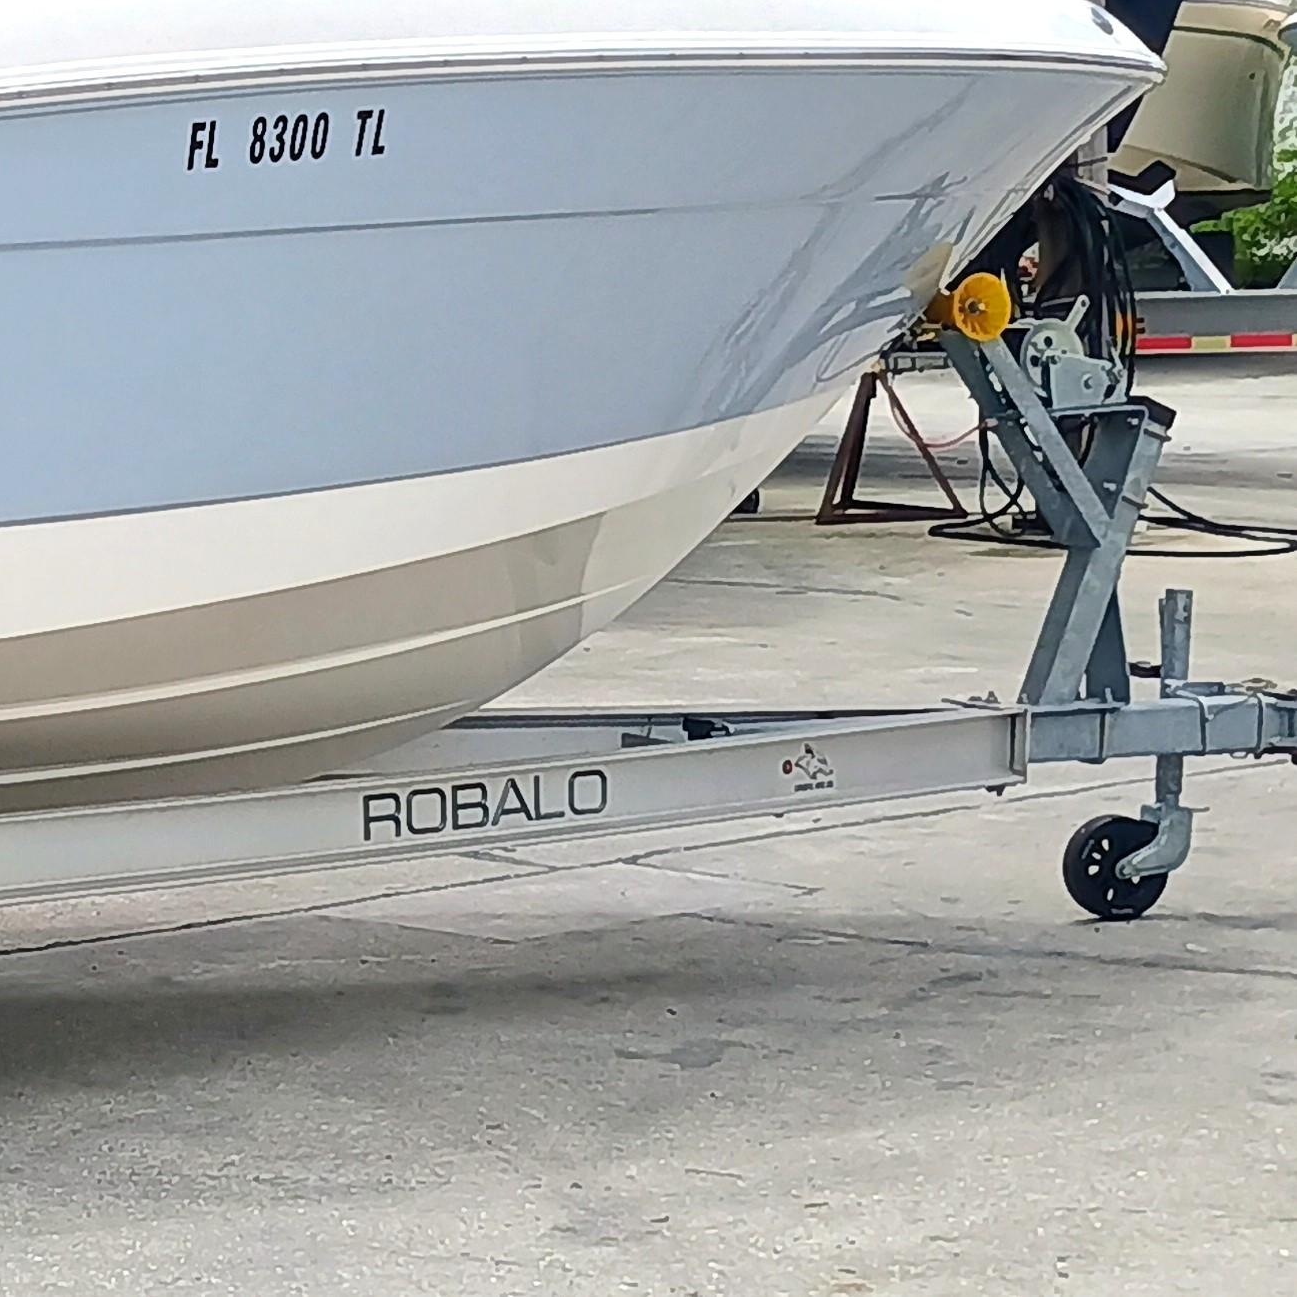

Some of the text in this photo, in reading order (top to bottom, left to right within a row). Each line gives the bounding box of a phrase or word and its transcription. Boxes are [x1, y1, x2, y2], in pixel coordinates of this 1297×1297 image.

[187, 108, 386, 171] FL 8300 TL
[362, 769, 608, 842] ROBALO
